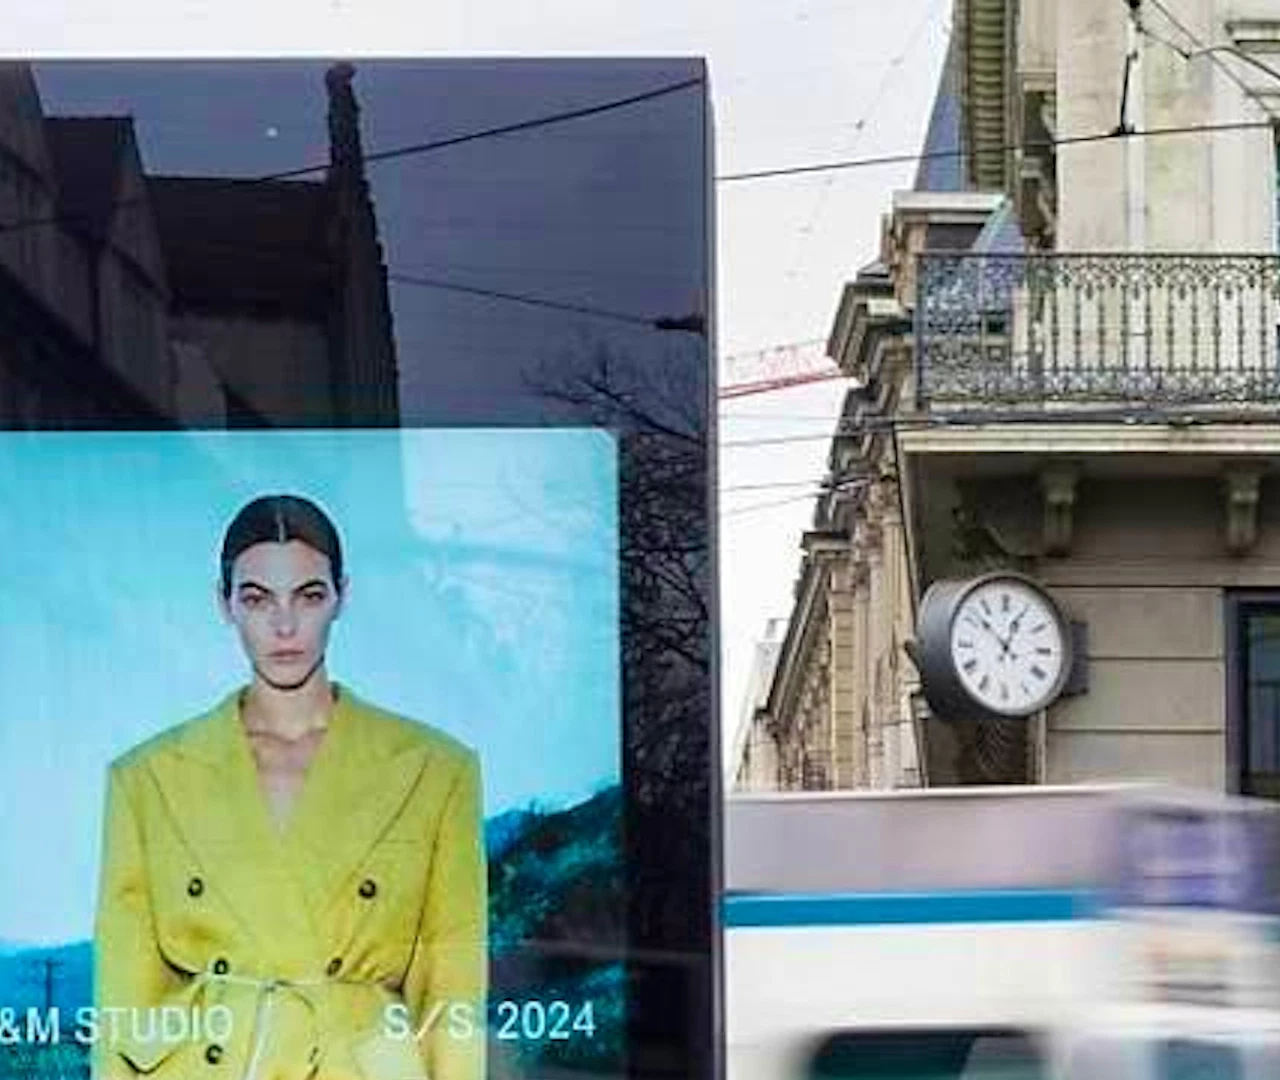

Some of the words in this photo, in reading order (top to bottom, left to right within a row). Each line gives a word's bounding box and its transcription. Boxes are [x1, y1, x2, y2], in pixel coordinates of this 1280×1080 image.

[75, 1006, 233, 1041] STUDIO
[382, 1002, 476, 1041] S/S
[497, 1001, 595, 1039] 2024
